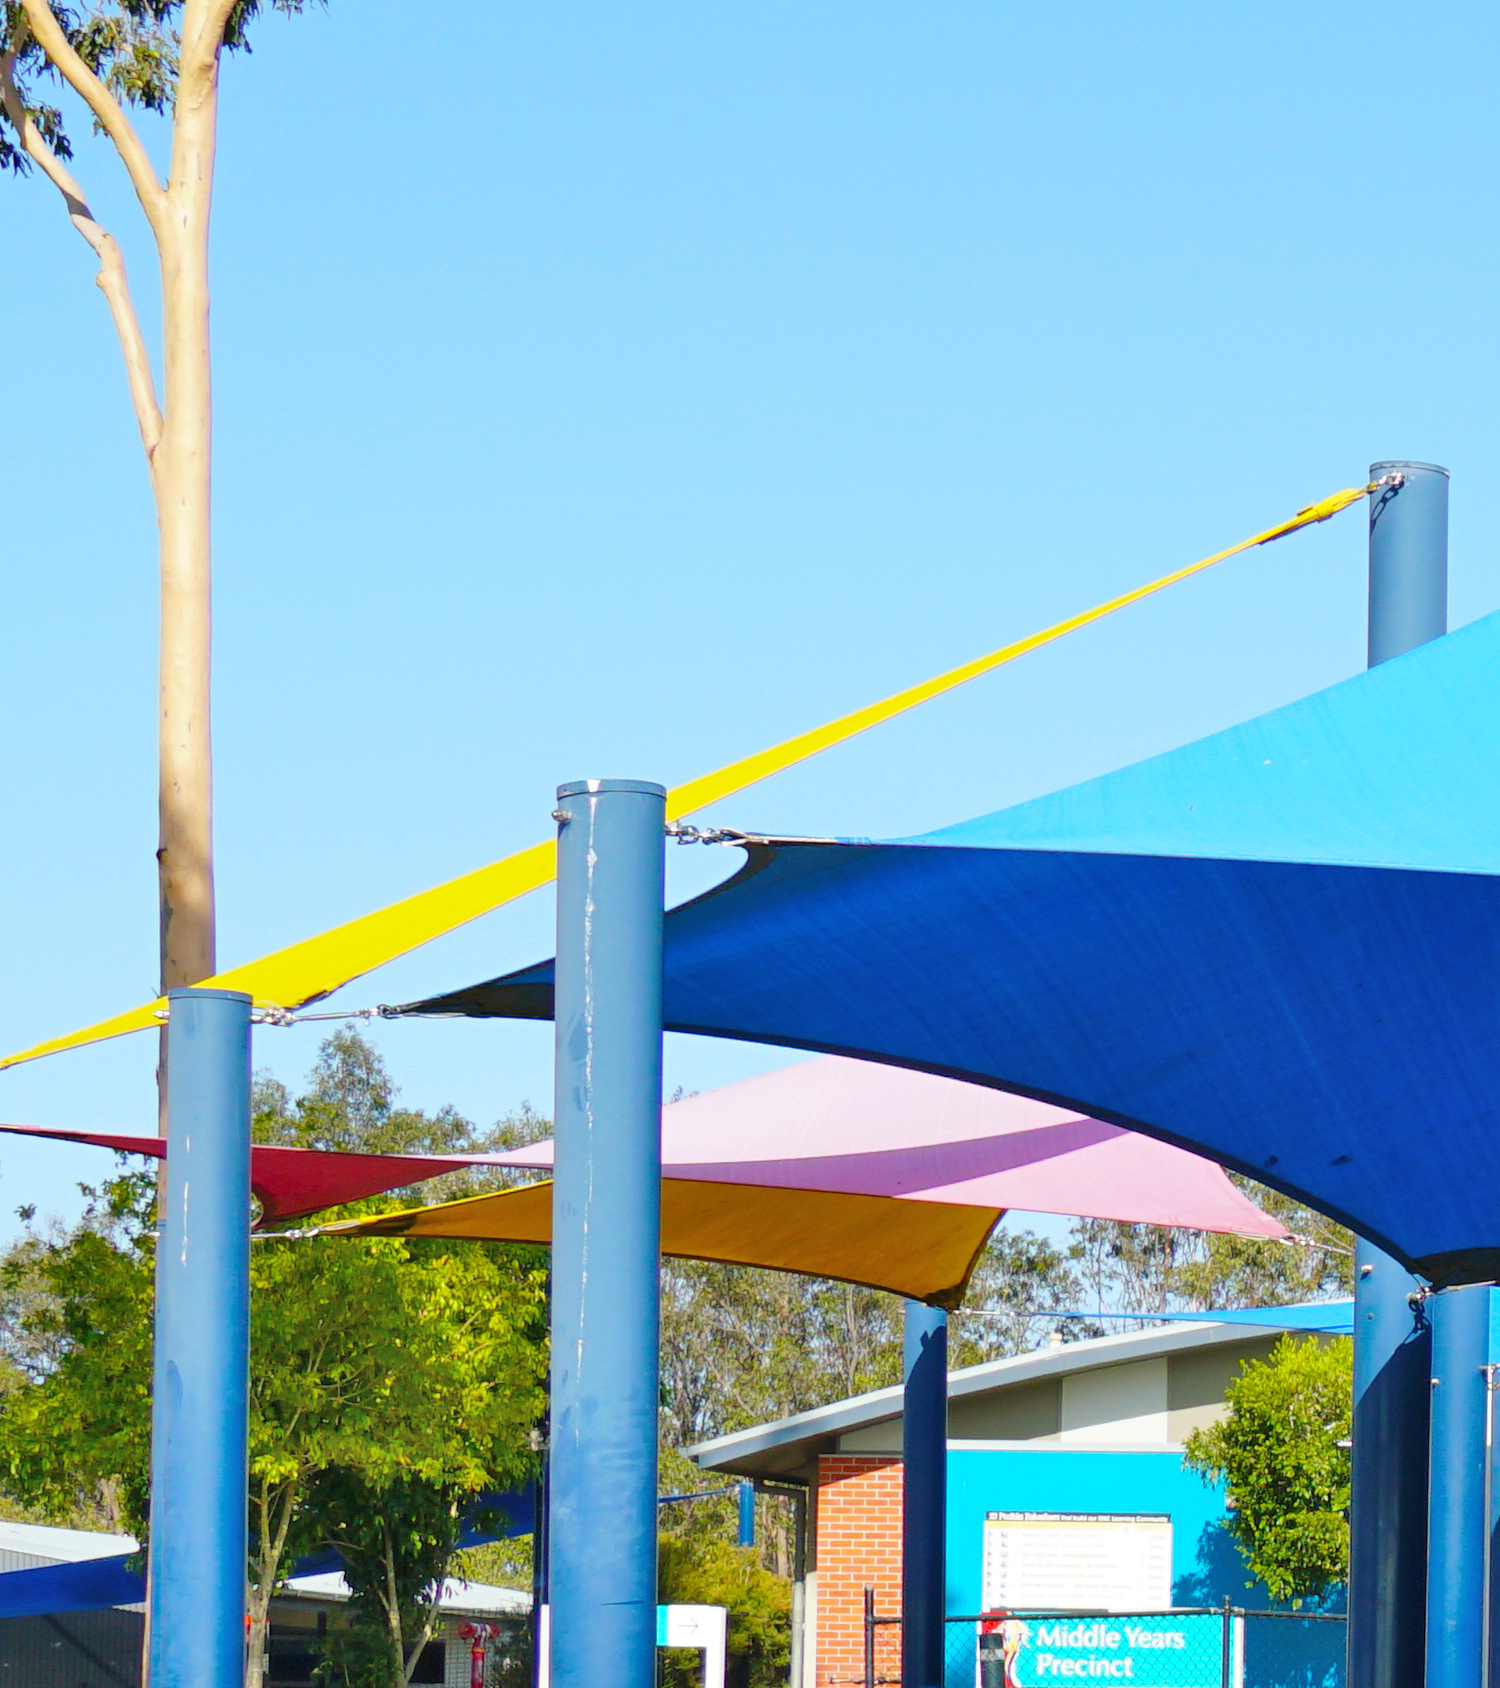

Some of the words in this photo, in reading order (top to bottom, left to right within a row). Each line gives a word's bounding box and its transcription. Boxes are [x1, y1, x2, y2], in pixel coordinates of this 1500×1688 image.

[1036, 1624, 1121, 1649] Middle
[1124, 1626, 1186, 1649] Years
[1036, 1653, 1133, 1677] Precinct
